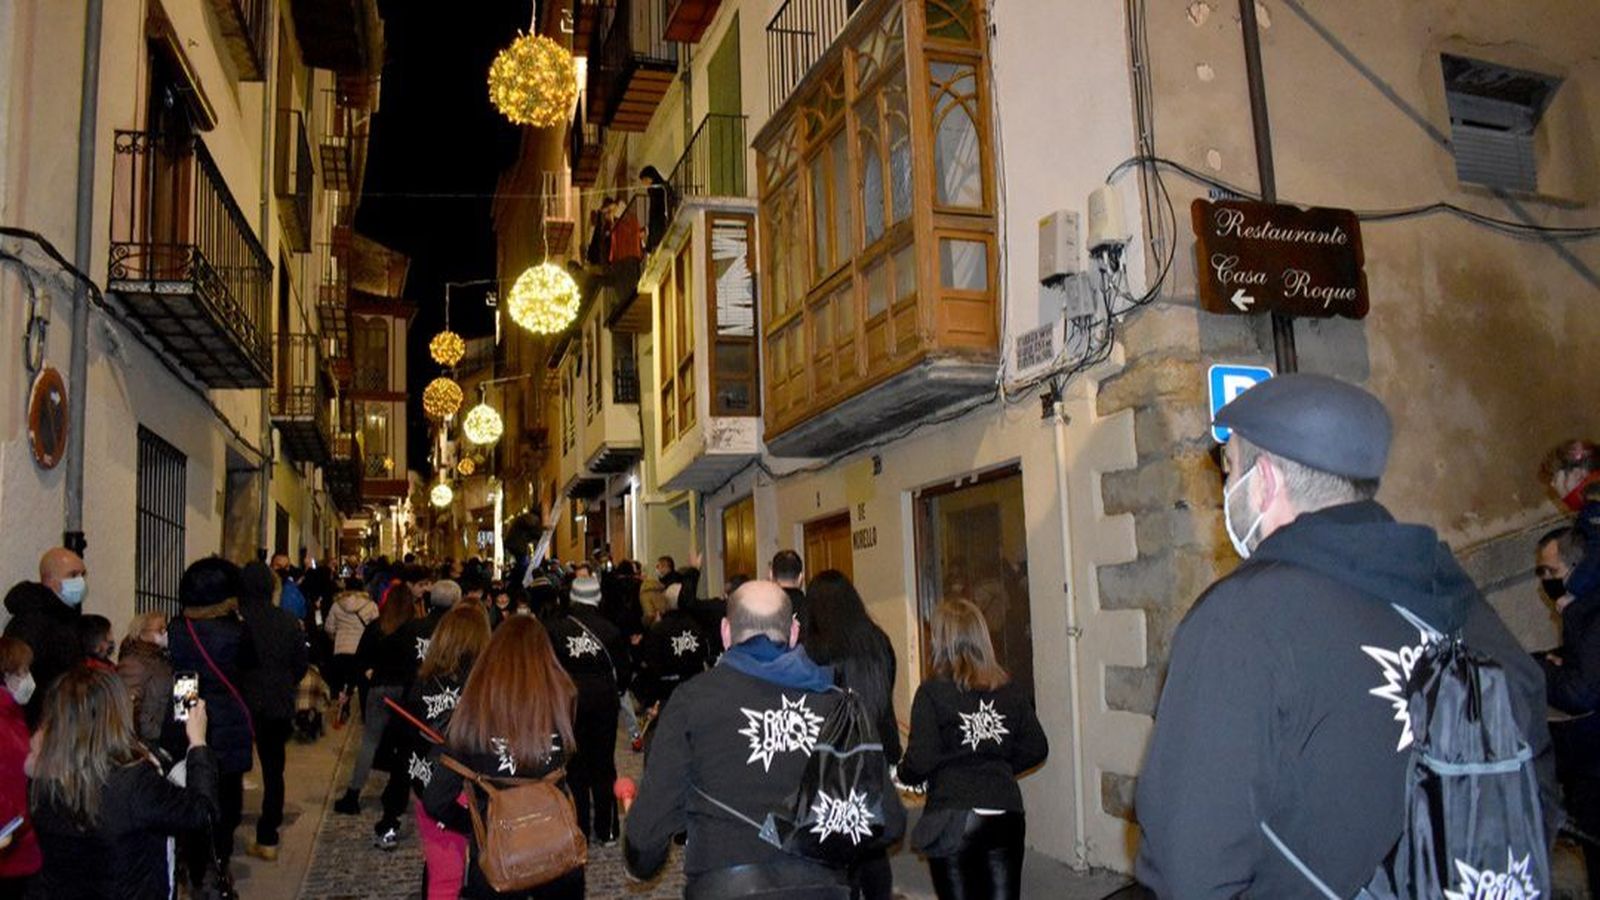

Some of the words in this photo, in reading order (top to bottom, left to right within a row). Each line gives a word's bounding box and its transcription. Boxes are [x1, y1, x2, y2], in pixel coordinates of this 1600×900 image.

[1214, 208, 1348, 245] Restaurante
[1211, 253, 1268, 285] Casa
[1282, 268, 1357, 308] Roque
